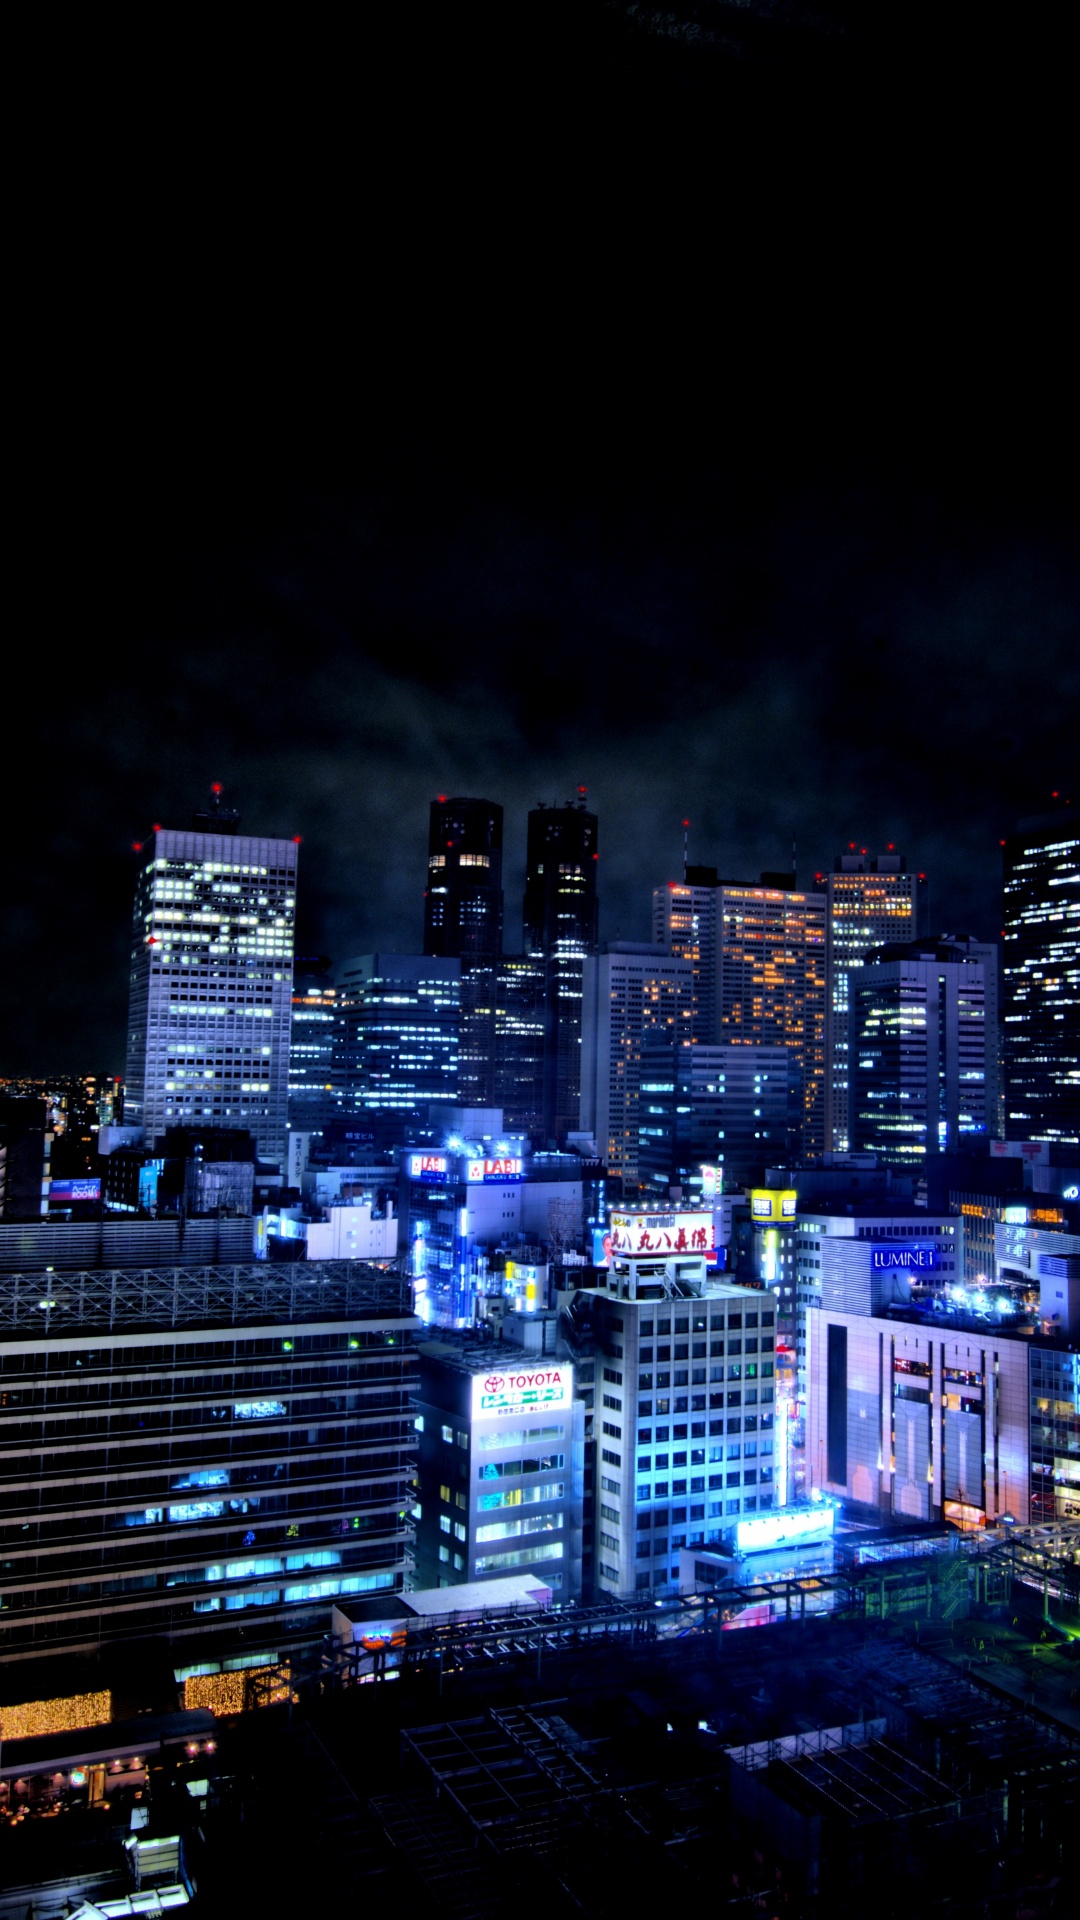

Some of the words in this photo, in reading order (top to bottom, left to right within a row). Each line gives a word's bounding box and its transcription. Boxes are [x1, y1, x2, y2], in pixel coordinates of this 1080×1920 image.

[421, 1157, 443, 1172] LABI
[484, 1159, 518, 1174] LABI
[874, 1251, 925, 1267] LUMINE
[508, 1372, 561, 1389] TOYOTA
